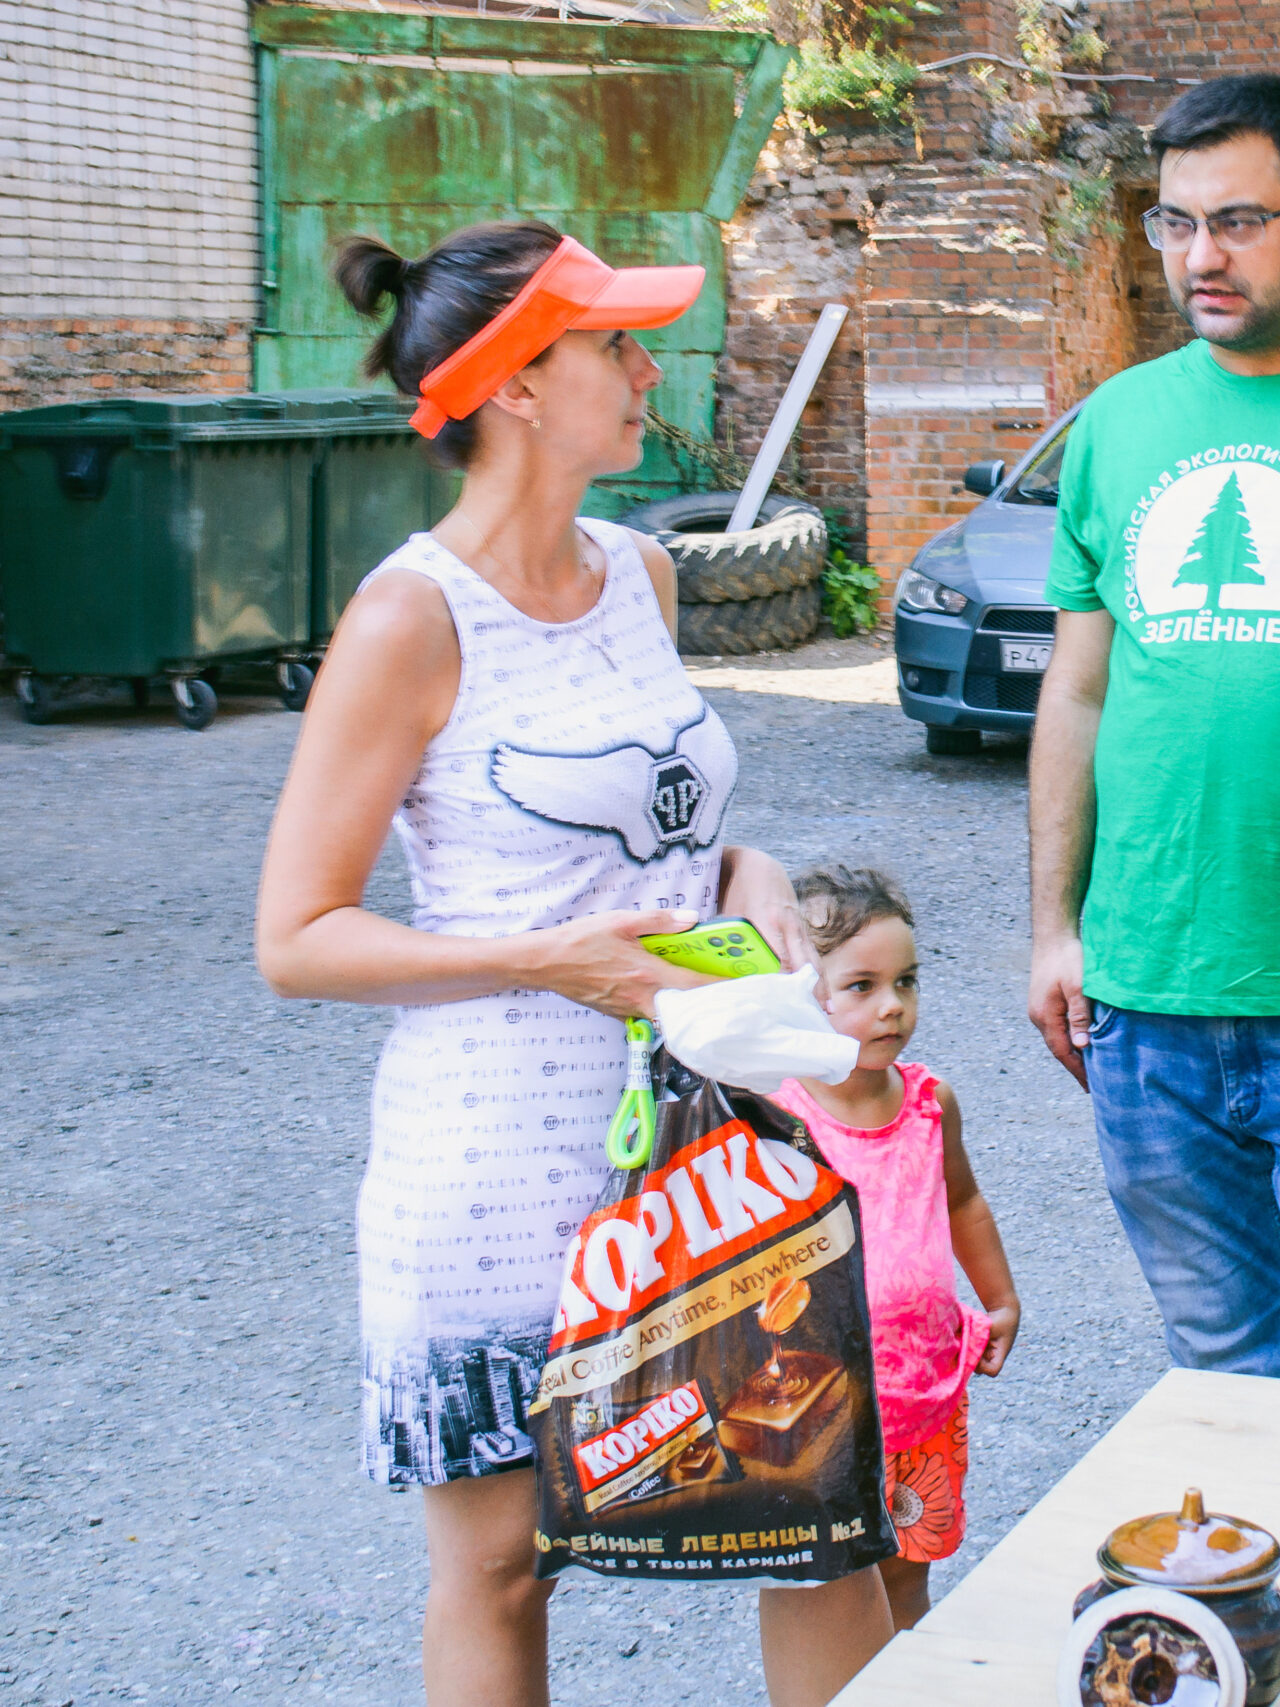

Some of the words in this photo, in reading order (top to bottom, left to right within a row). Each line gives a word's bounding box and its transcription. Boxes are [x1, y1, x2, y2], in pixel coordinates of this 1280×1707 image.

[561, 1113, 612, 1126] PHILIP
[552, 1132, 818, 1334] KOPIKO
[730, 1235, 832, 1301] Anywhere
[577, 1386, 700, 1480] KOPIKO
[630, 1474, 662, 1499] Coffee
[680, 1524, 819, 1554] ЛЕДЕНЦЫ
[626, 1558, 639, 1569] В
[646, 1558, 713, 1570] ТВОЕМ
[721, 1549, 814, 1569] КАРМАНЕ
